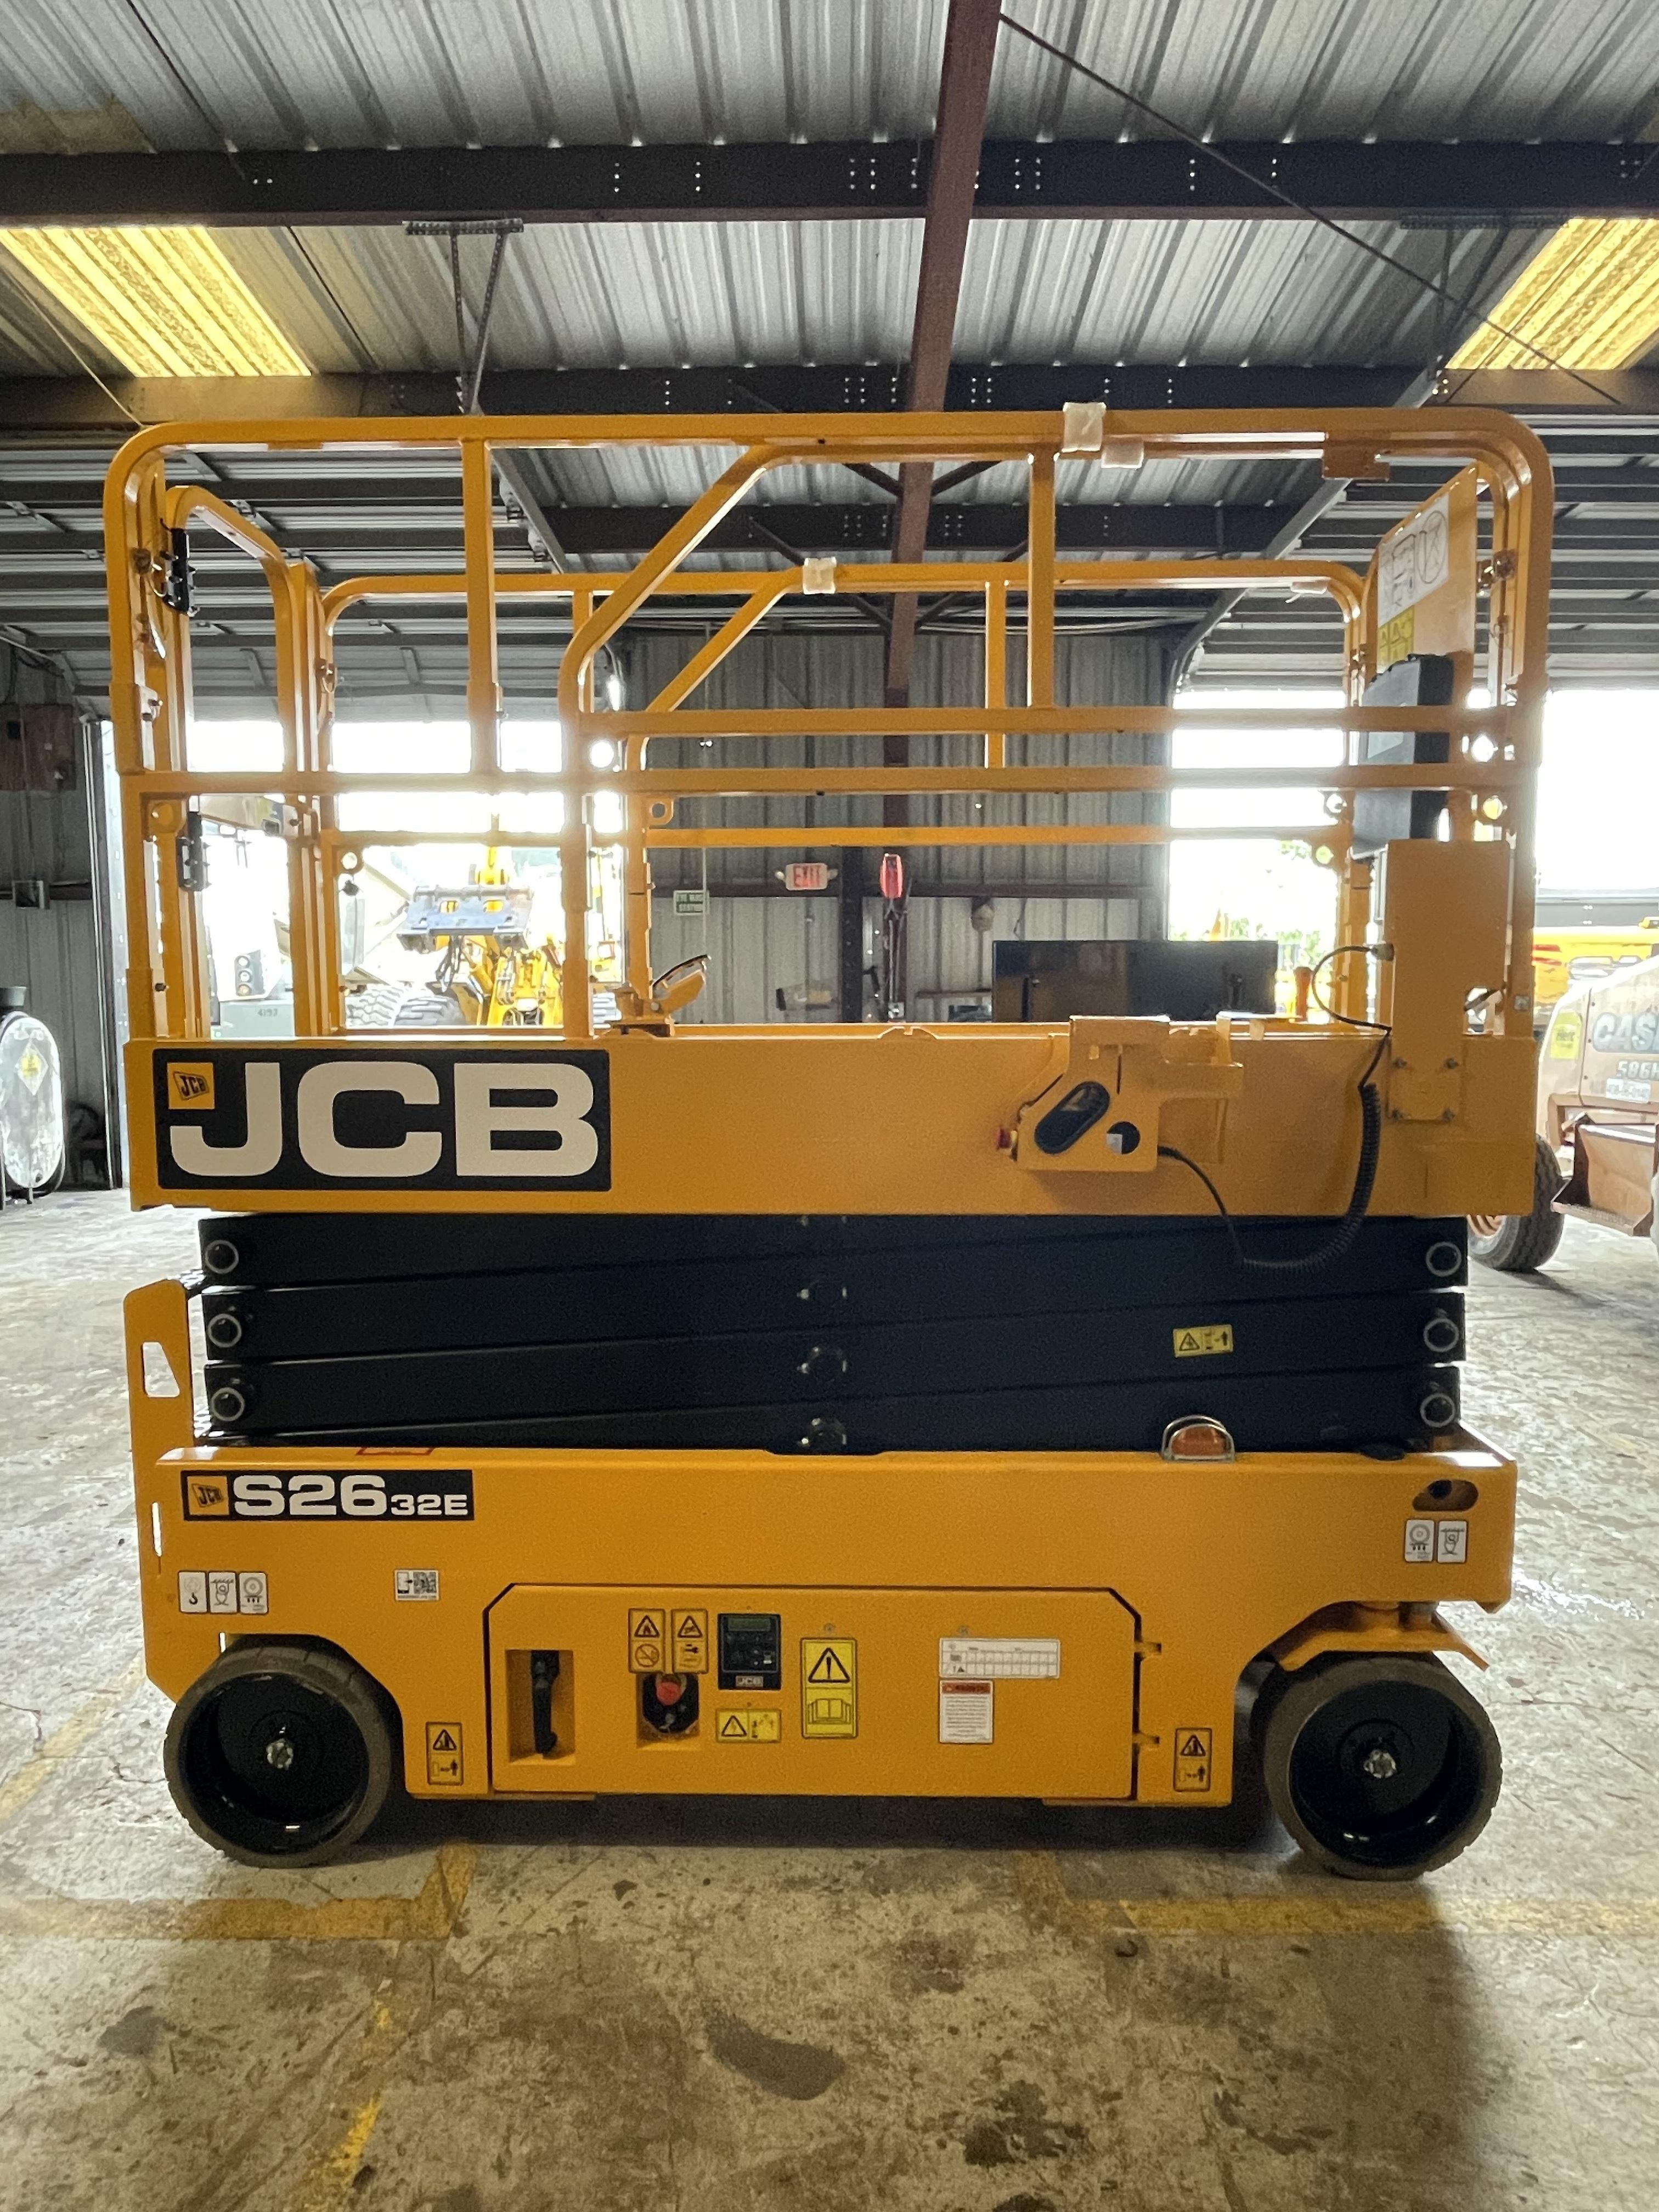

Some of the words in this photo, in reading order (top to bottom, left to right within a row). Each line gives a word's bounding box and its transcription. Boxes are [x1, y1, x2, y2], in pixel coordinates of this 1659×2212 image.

[793, 865, 822, 888] EXIT
[1593, 1013, 1659, 1051] CAS
[179, 1075, 207, 1097] JCB
[170, 1061, 599, 1177] JCB
[198, 1486, 222, 1504] JCB
